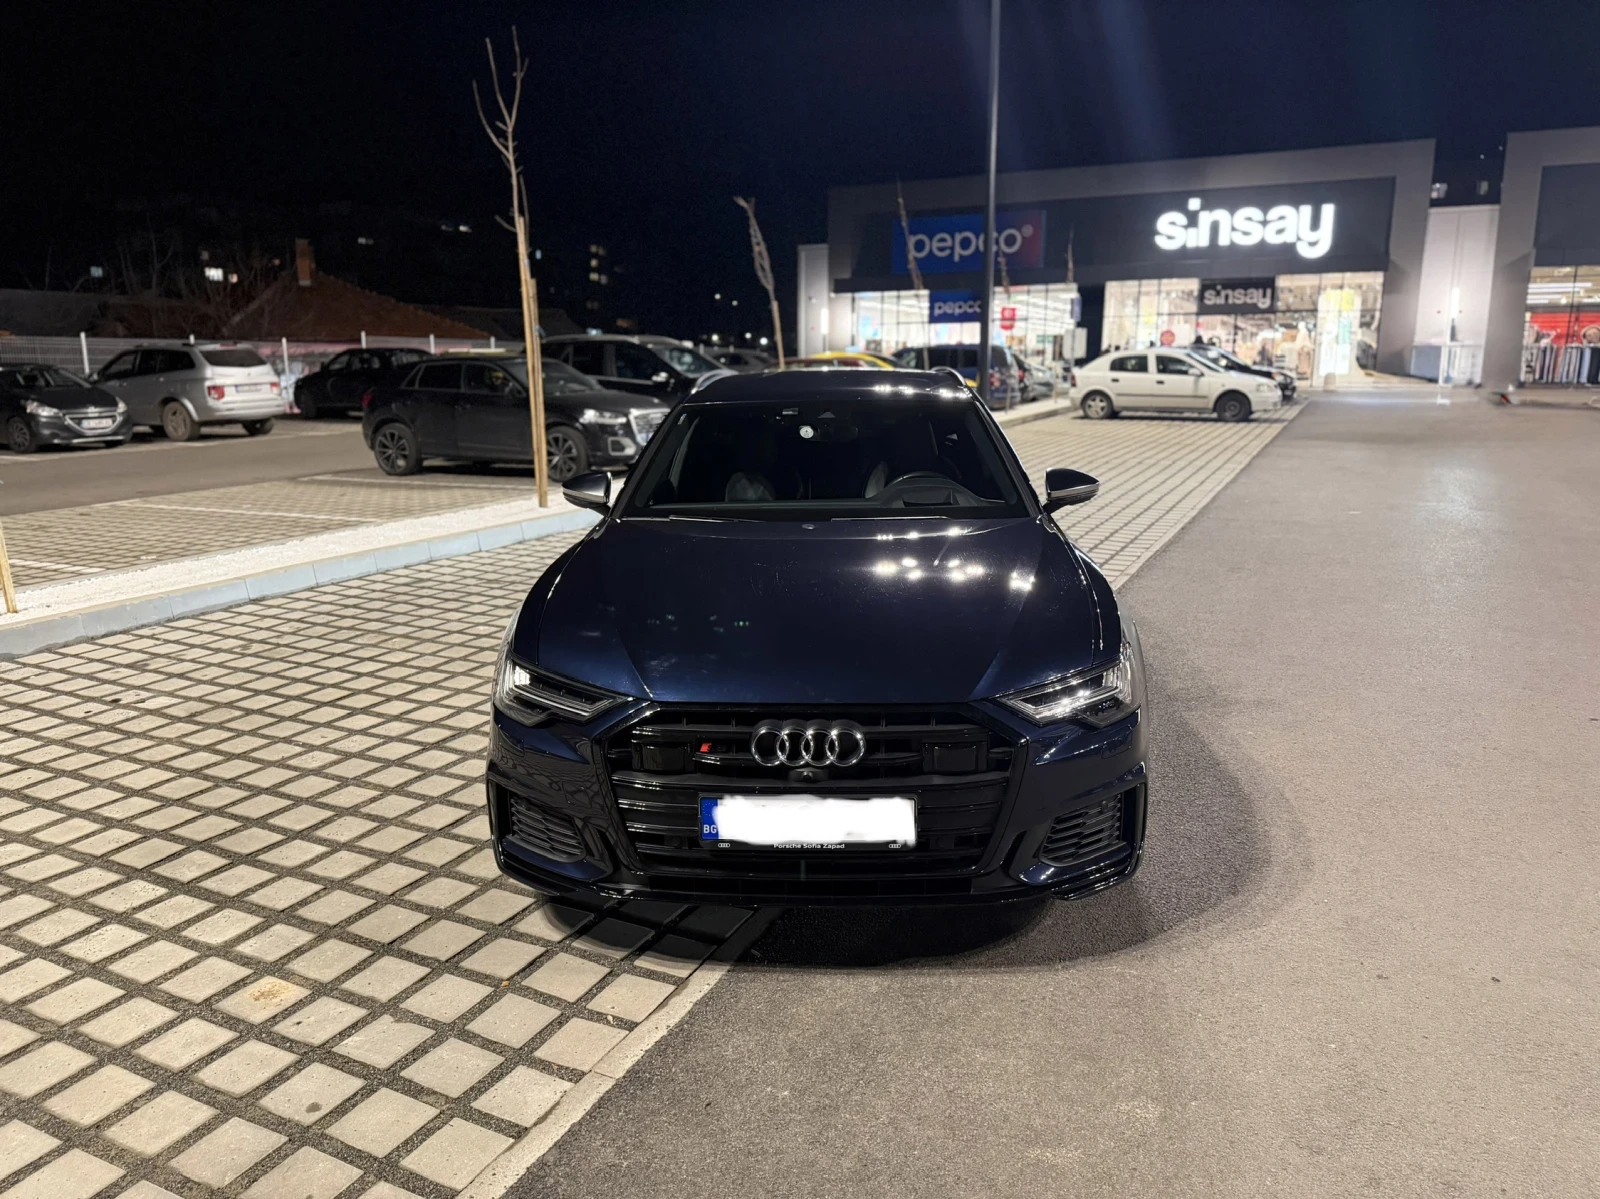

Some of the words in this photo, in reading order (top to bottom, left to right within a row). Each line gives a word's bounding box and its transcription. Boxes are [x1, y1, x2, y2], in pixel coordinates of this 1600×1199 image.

[1154, 197, 1336, 260] sinsay
[1203, 284, 1273, 309] sinsay
[703, 824, 717, 834] BG
